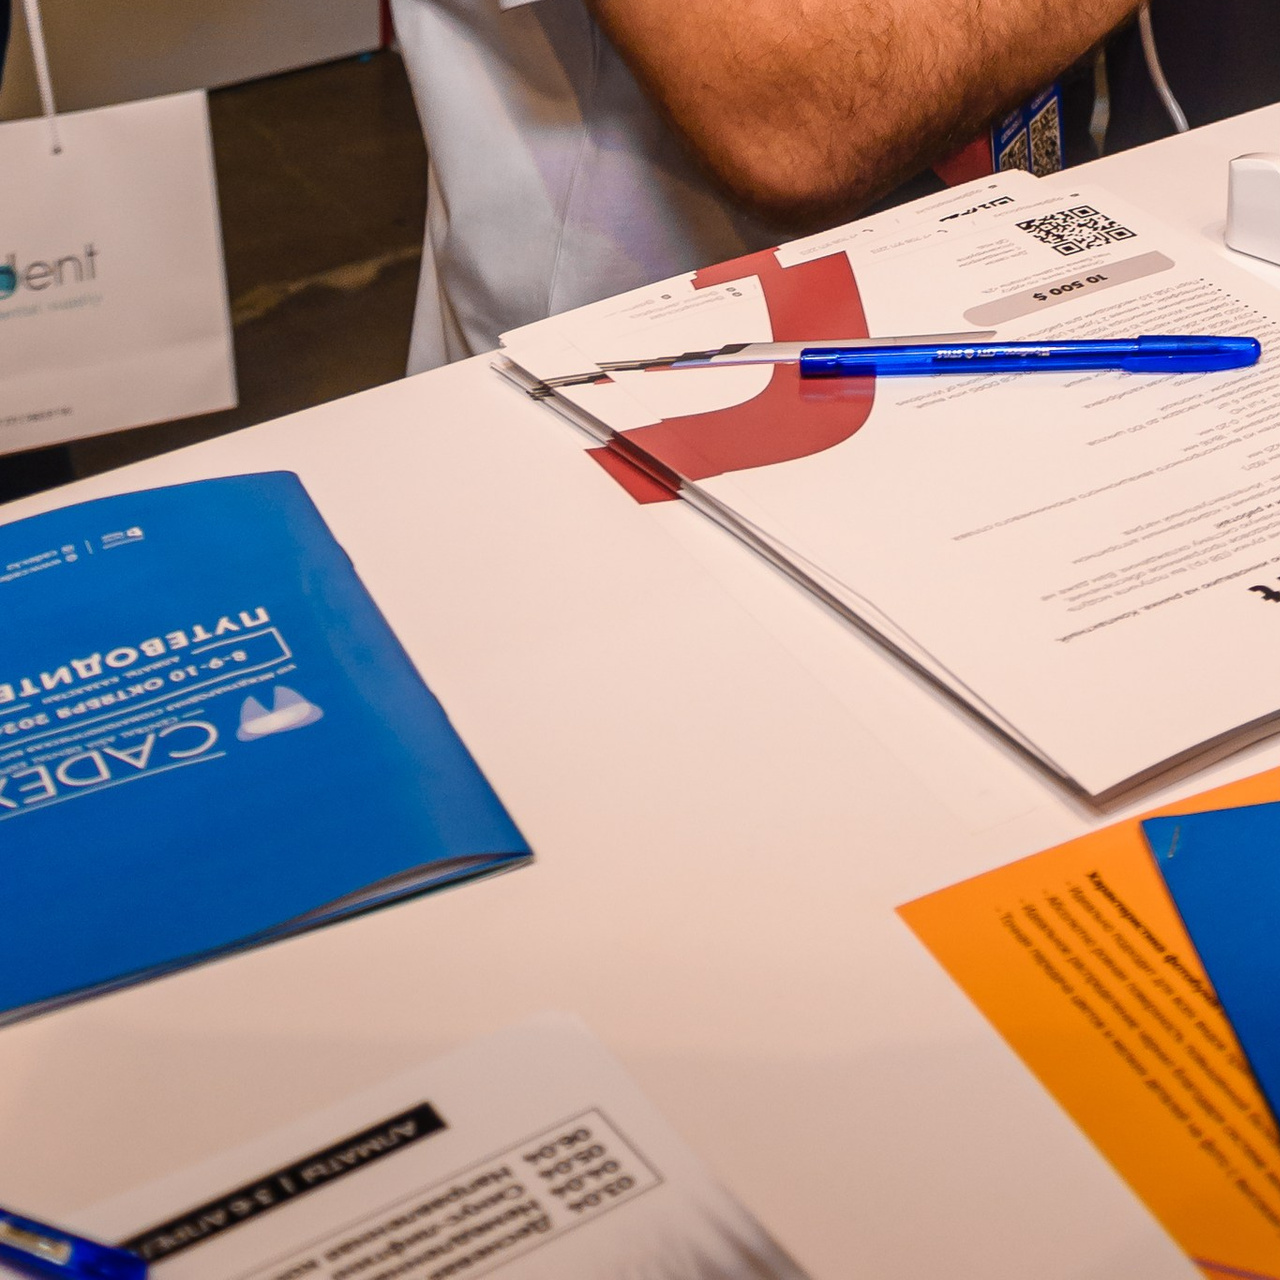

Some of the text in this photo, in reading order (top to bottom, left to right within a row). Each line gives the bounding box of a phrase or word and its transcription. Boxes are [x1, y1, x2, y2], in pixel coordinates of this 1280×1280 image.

[1027, 272, 1109, 302] 10 500 $
[0, 605, 271, 704] ПУТЕВОДИТЕ
[0, 646, 250, 738] 8-9-10 ОКТЯБРЯ 202
[133, 1203, 231, 1263] АПРЕЛ
